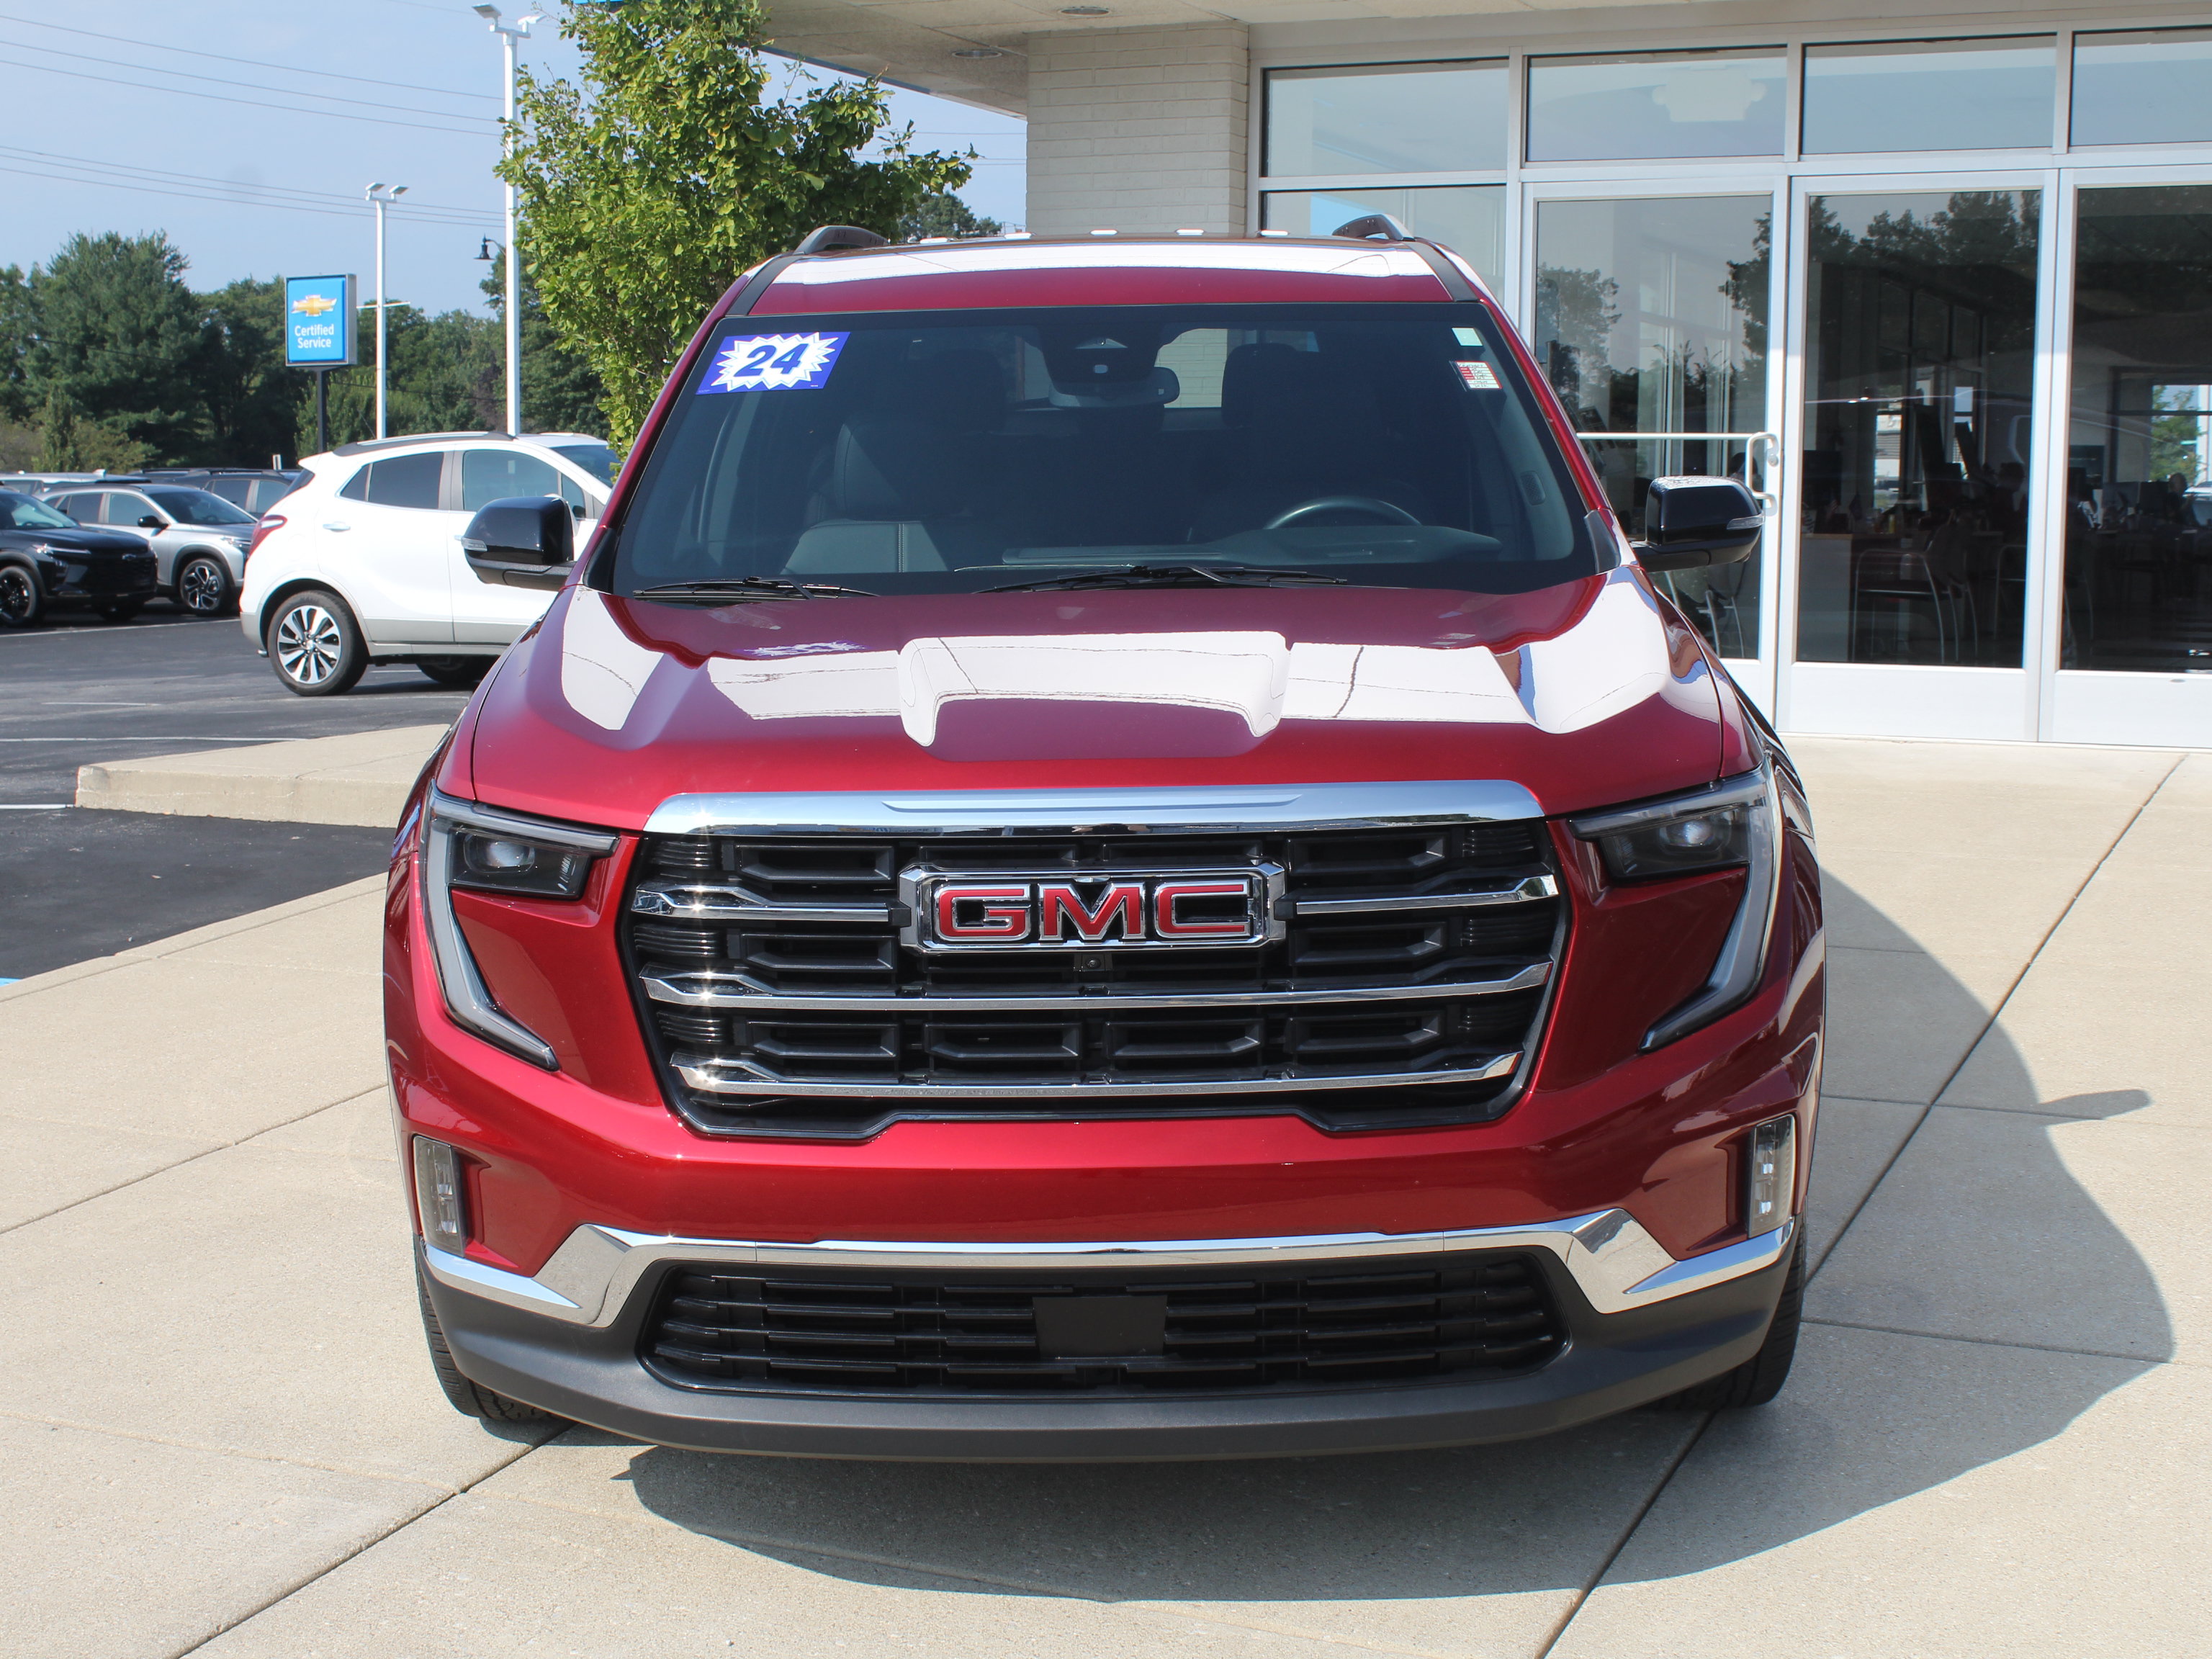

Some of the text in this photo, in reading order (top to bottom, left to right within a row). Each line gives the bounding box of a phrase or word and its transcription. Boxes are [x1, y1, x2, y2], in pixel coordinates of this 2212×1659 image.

[295, 324, 334, 336] Certified
[297, 337, 332, 349] Service
[733, 343, 809, 377] 24
[935, 883, 1250, 940] GMC
